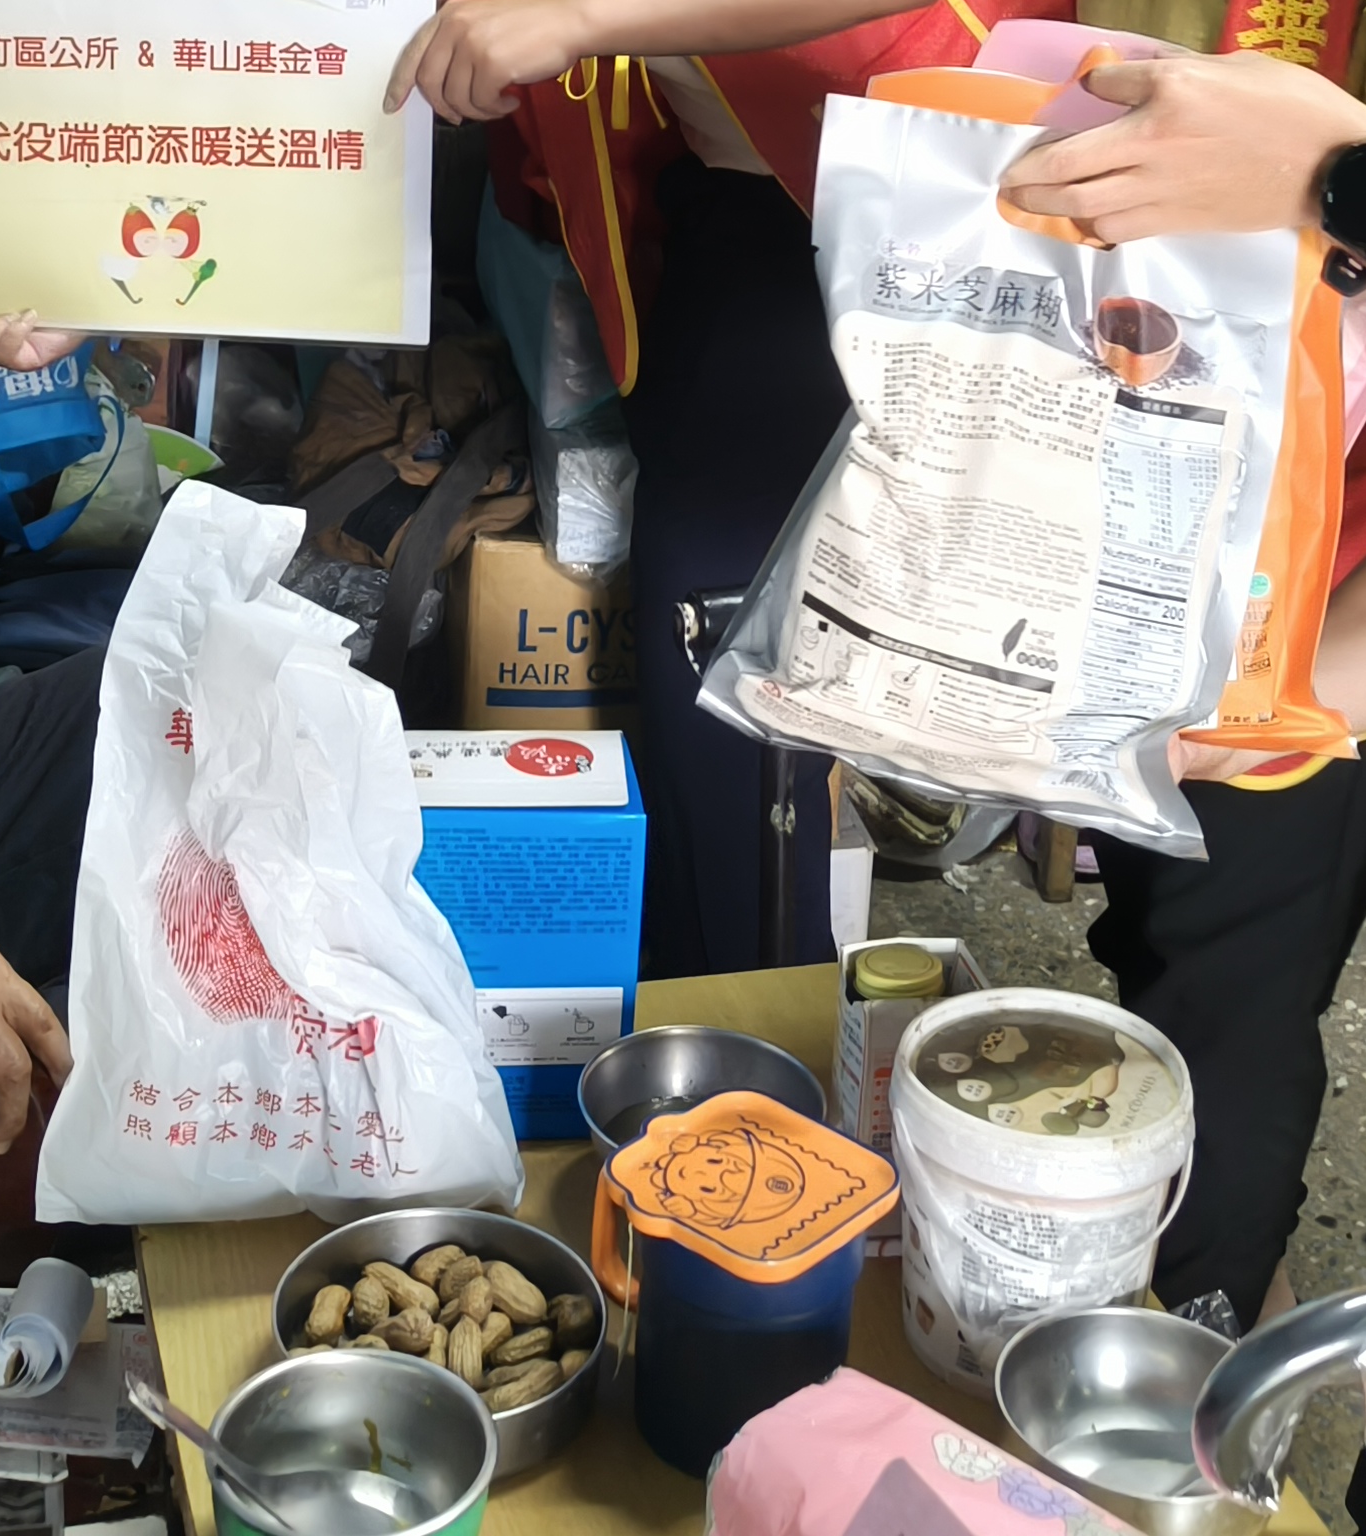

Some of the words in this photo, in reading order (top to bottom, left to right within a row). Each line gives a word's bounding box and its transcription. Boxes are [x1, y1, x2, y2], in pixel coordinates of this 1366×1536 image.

[138, 40, 155, 69] &
[173, 38, 349, 75] 華山基金會
[875, 262, 1065, 328] 紫米芝麻糊
[1161, 605, 1186, 621] 200
[498, 662, 570, 685] HAIR
